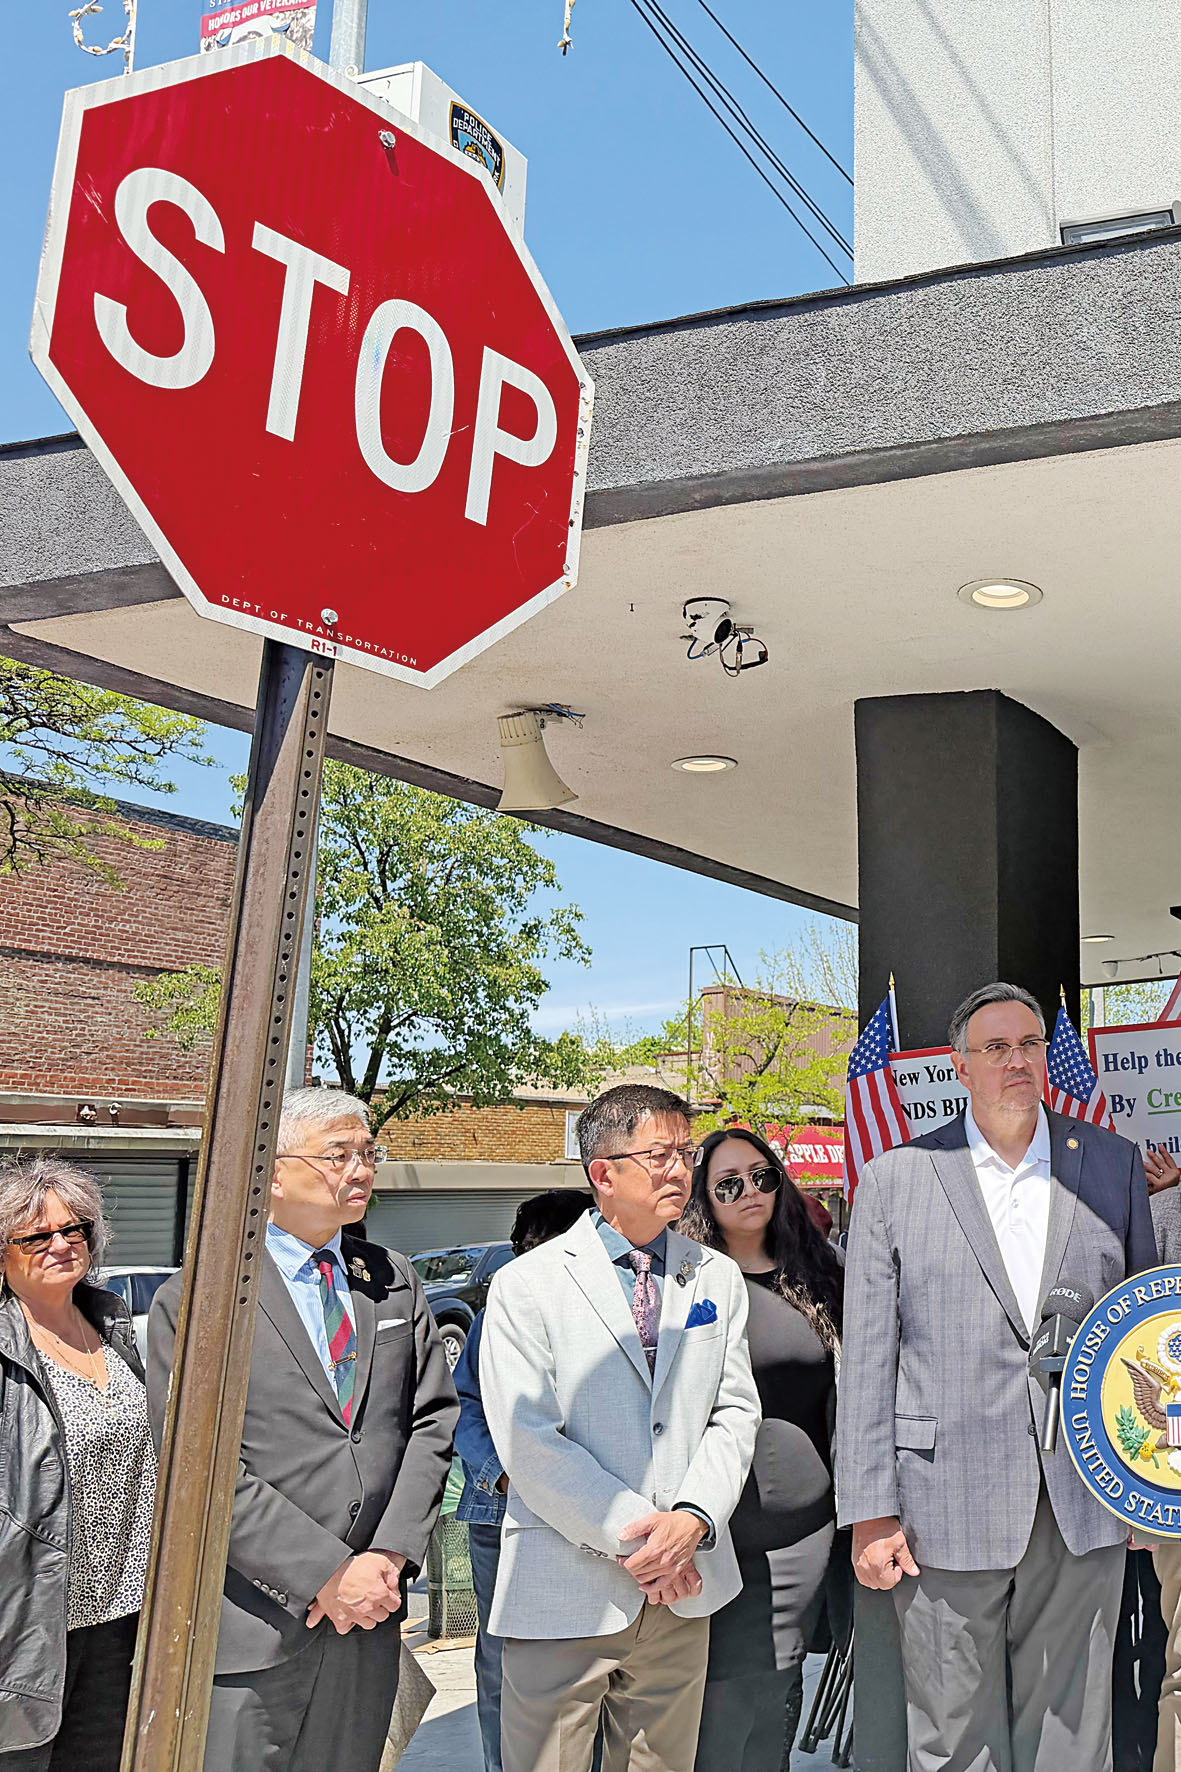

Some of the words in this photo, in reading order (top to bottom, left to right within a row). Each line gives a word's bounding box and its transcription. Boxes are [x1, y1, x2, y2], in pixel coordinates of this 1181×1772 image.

[242, 3, 259, 18] OUR
[260, 0, 307, 11] VETER
[464, 112, 493, 141] POLICE
[453, 117, 501, 167] DEPARTMENT
[93, 167, 559, 527] STOP
[221, 594, 262, 613] DEPT
[270, 610, 288, 621] OF
[296, 618, 418, 666] TRANSPORTATION
[310, 638, 338, 657] R1-1
[1103, 1052, 1149, 1075] Help
[901, 1100, 937, 1121] NDS
[1110, 1094, 1137, 1118] By
[1070, 1320, 1110, 1401] HOUSE
[1107, 1298, 1132, 1325] OF
[1071, 1410, 1124, 1500] UNITED
